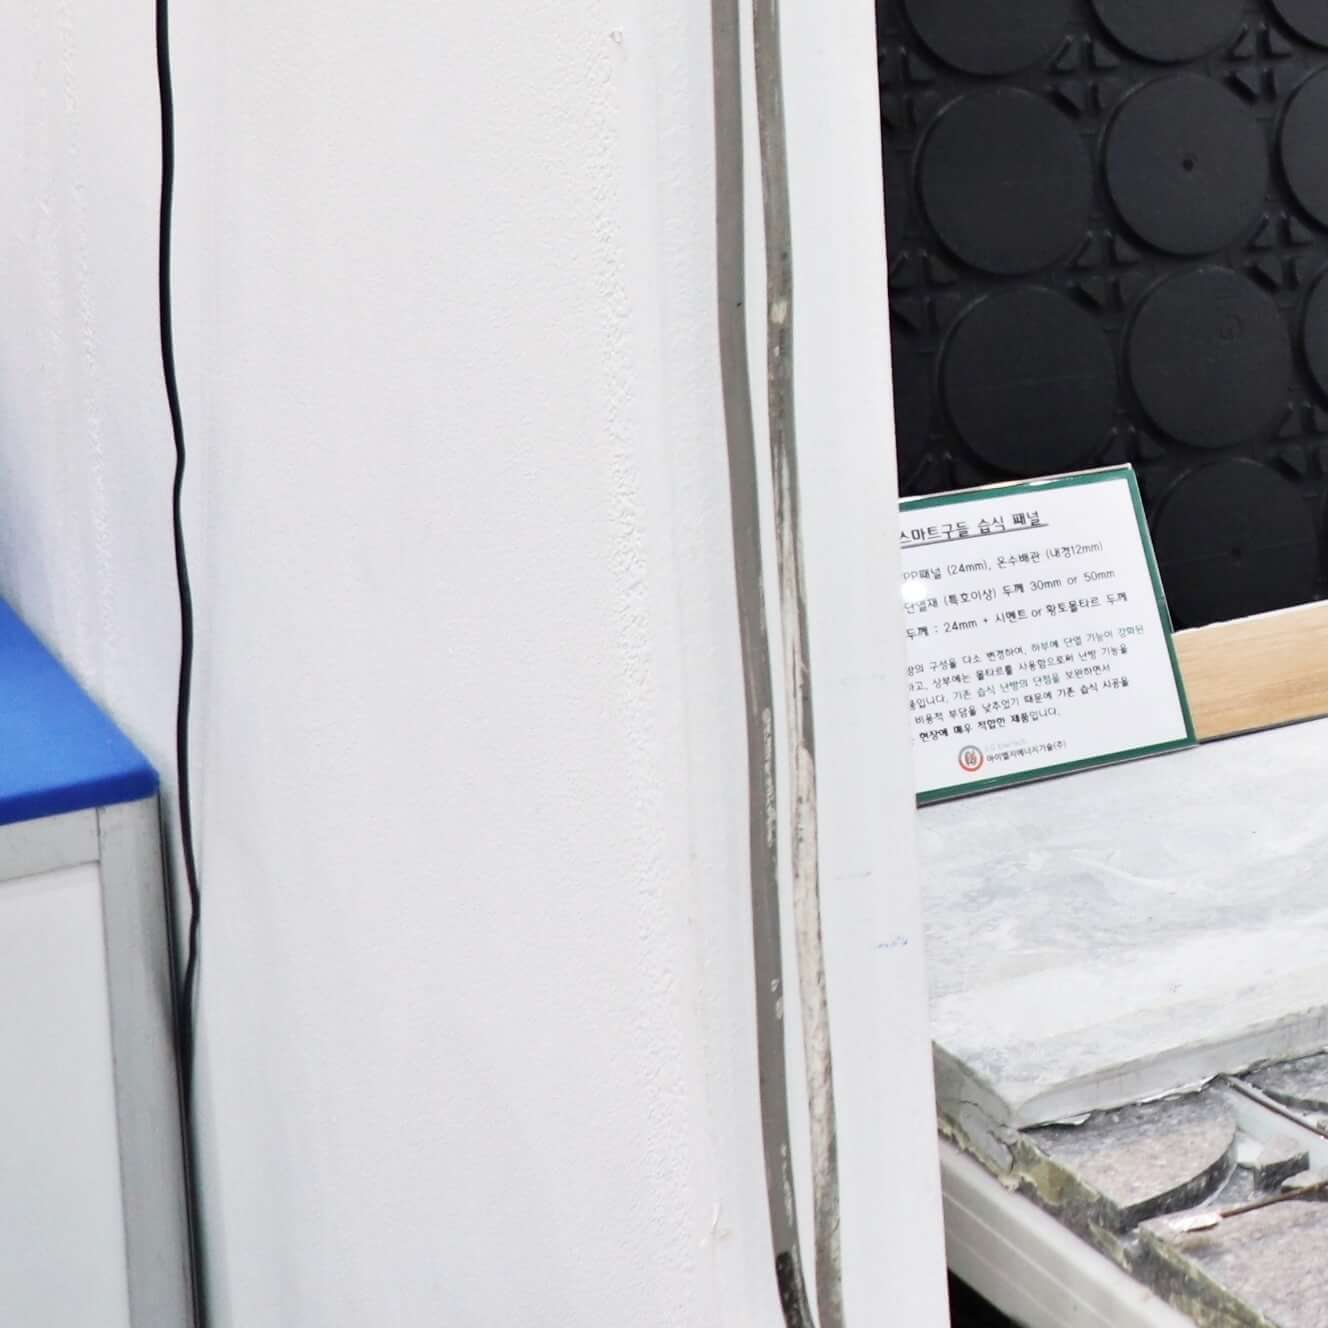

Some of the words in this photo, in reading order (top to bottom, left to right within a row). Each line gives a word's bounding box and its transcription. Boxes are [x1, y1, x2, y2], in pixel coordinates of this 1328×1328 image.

[901, 522, 969, 543] 스마트구들
[977, 516, 1006, 534] 습식
[1012, 510, 1041, 526] 패널
[997, 550, 1040, 569] 온수배관
[1046, 540, 1103, 560] (내경12mm)
[1002, 583, 1024, 597] 두께
[1030, 578, 1062, 592] 30mm
[1067, 576, 1077, 586] or
[1083, 569, 1115, 583] 50mm
[906, 626, 929, 640] 두께
[944, 620, 978, 633] 24mm
[994, 609, 1028, 624] 시멘트
[1031, 608, 1042, 618] or
[1106, 592, 1128, 606] 두께
